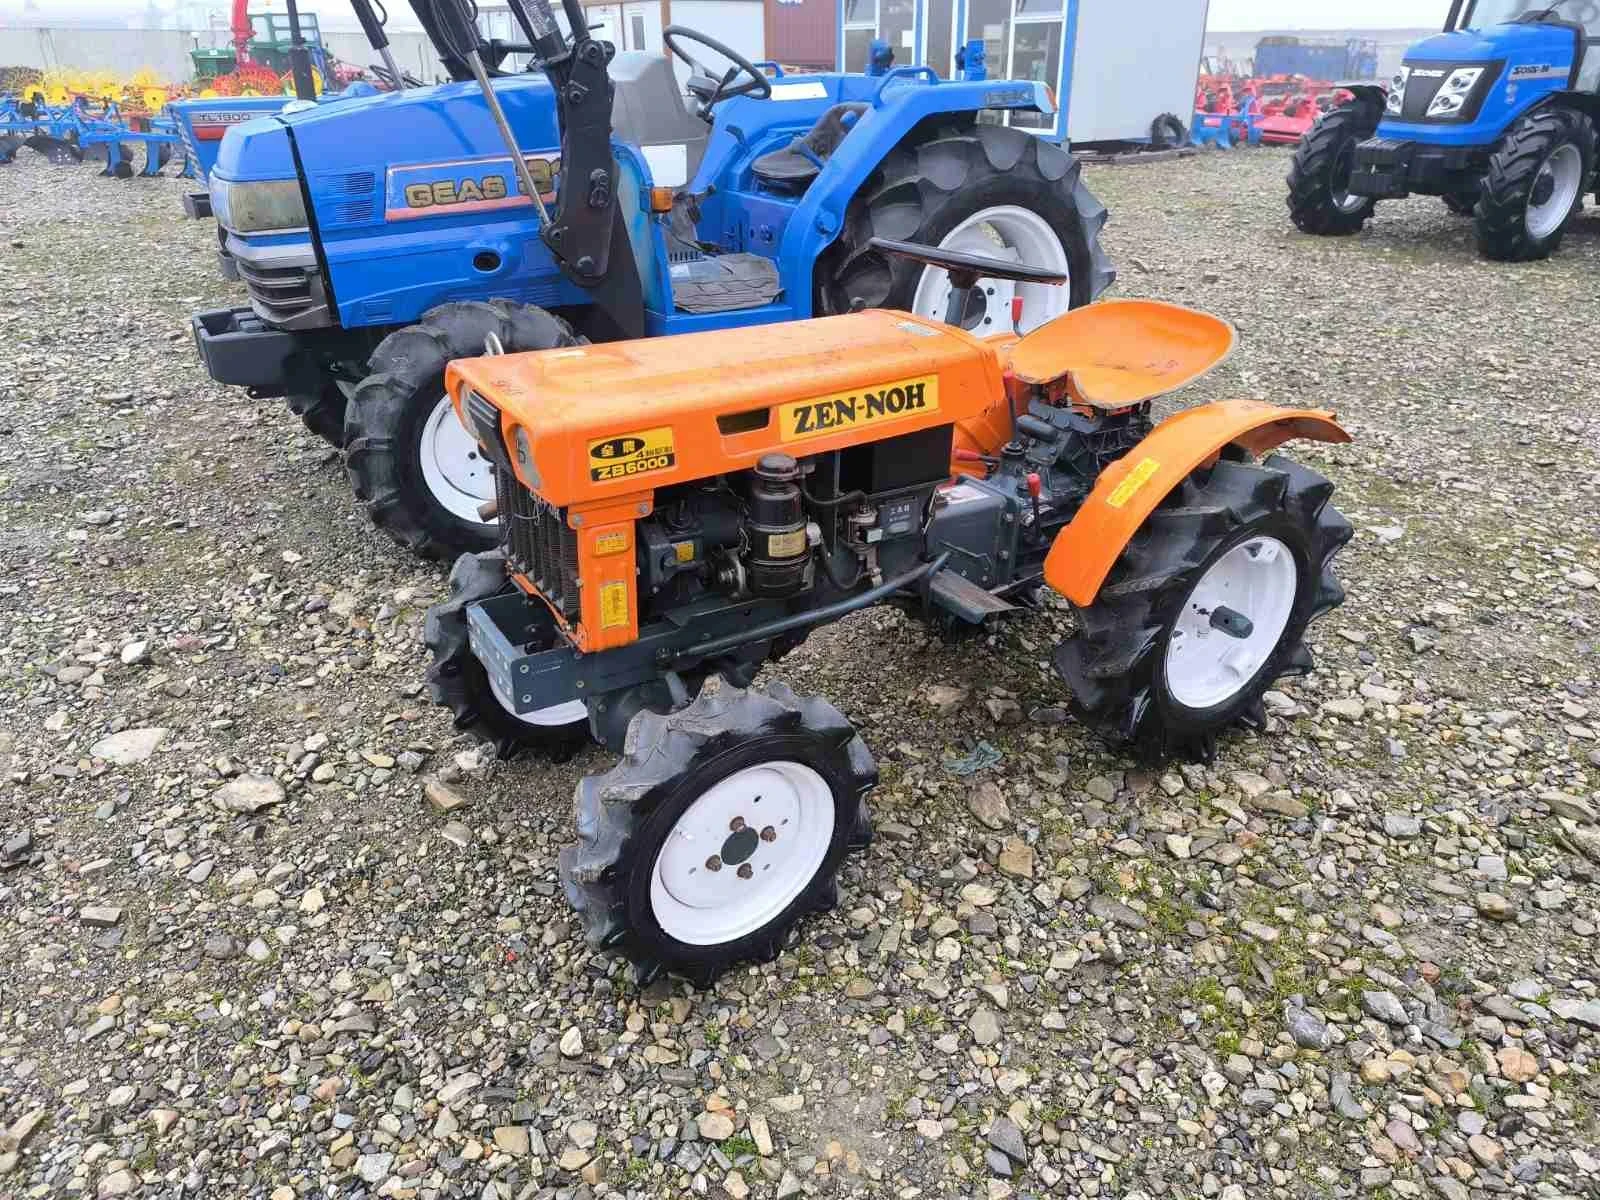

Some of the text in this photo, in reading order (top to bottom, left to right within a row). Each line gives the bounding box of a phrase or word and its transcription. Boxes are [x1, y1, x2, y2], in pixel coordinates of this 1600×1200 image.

[405, 175, 507, 208] GEAS
[793, 383, 926, 434] ZEN-NOH
[597, 456, 669, 480] ZB6000
